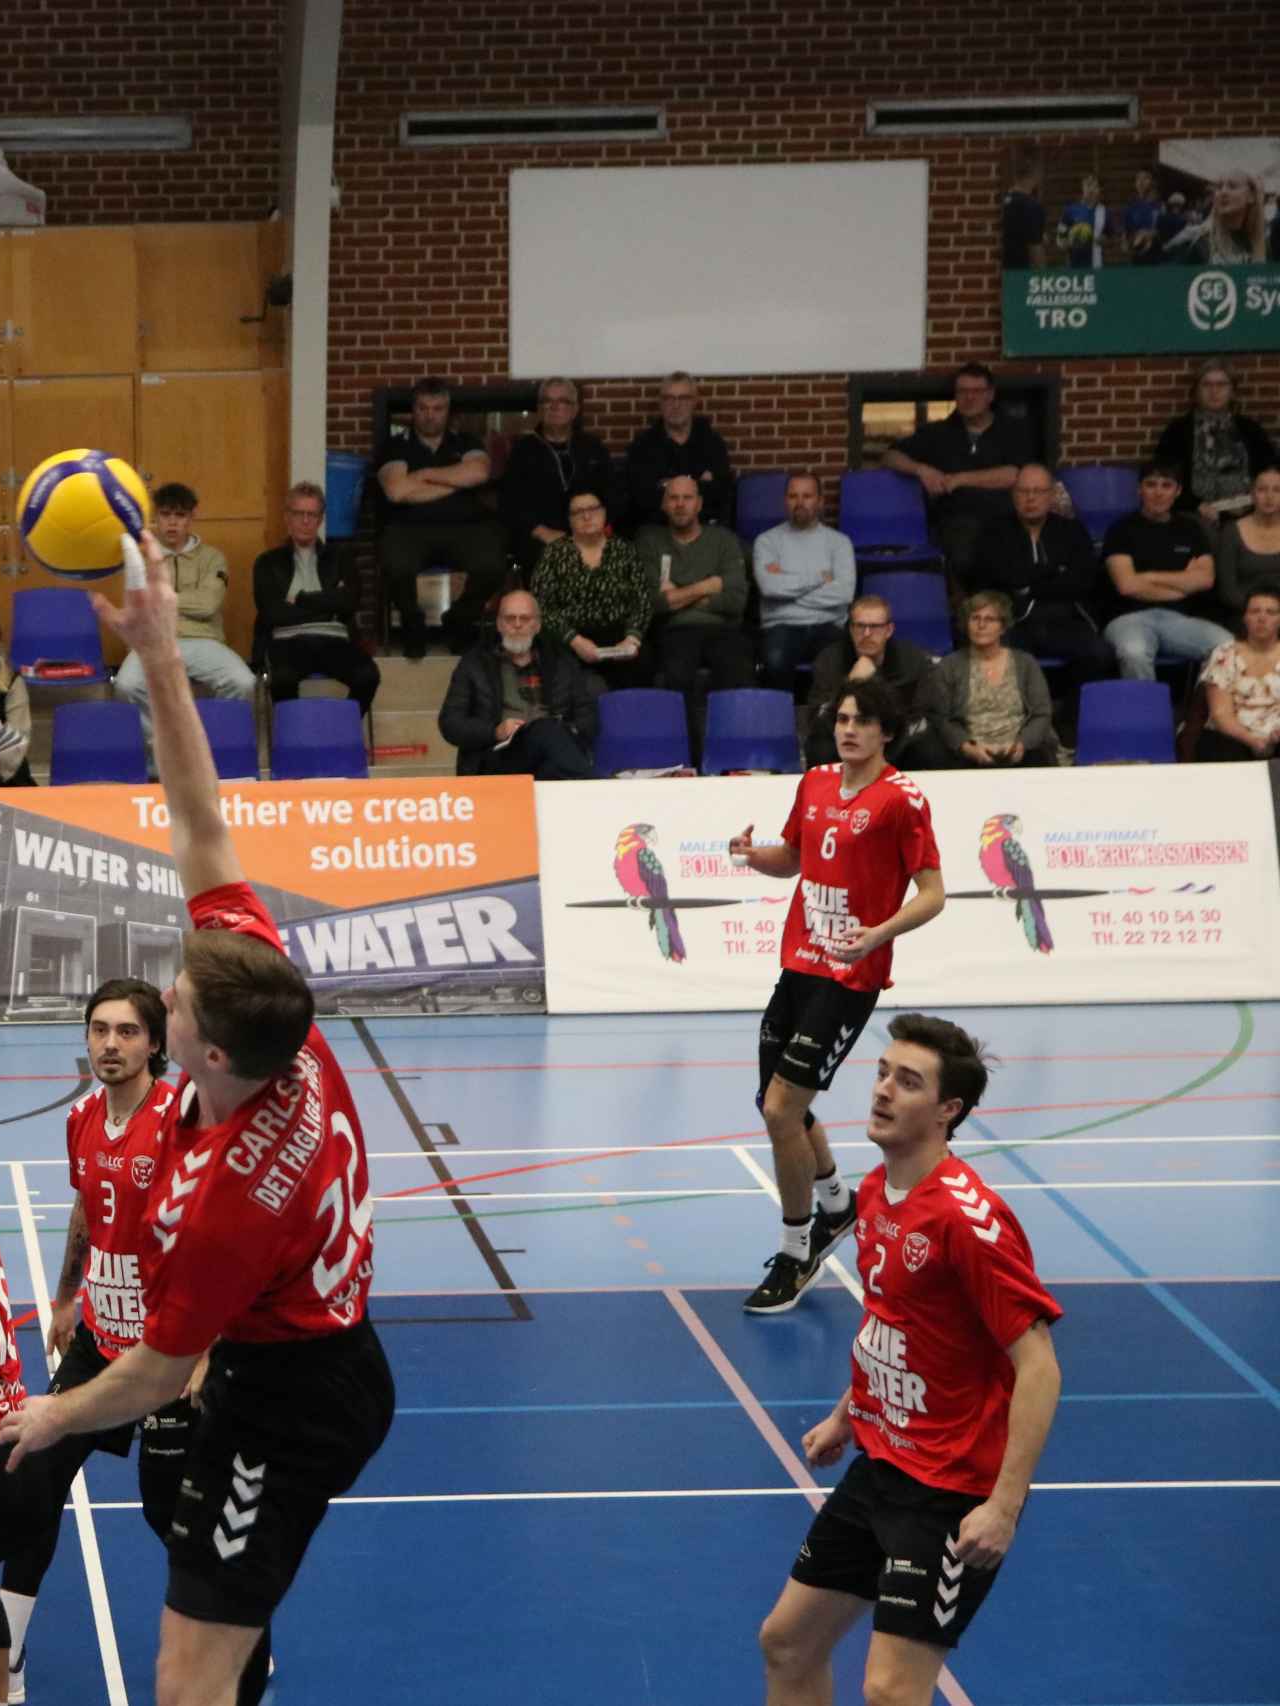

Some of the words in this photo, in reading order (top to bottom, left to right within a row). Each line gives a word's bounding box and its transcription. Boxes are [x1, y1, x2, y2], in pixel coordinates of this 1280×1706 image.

[1028, 275, 1095, 293] SKOLE
[1245, 286, 1280, 315] Sy
[1035, 308, 1088, 329] TRO
[131, 793, 292, 829] Tother
[302, 802, 353, 825] we
[364, 791, 475, 822] create
[15, 828, 129, 888] WATER
[309, 837, 478, 872] solutions
[820, 826, 838, 860] 6
[26, 891, 40, 903] 61
[754, 919, 775, 933] 40
[1122, 911, 1143, 925] 40
[1150, 910, 1169, 924] 10
[1175, 910, 1195, 924] 54
[1200, 909, 1221, 922] 30
[295, 896, 538, 974] WATER
[756, 939, 776, 953] 22
[1125, 931, 1145, 944] 22
[1151, 930, 1171, 944] 72
[1178, 930, 1197, 944] 12
[1203, 929, 1223, 943] 77
[254, 1164, 294, 1209] DET
[278, 1090, 321, 1173] FAGLIGE
[101, 1180, 116, 1224] 3
[869, 1243, 884, 1296] 2
